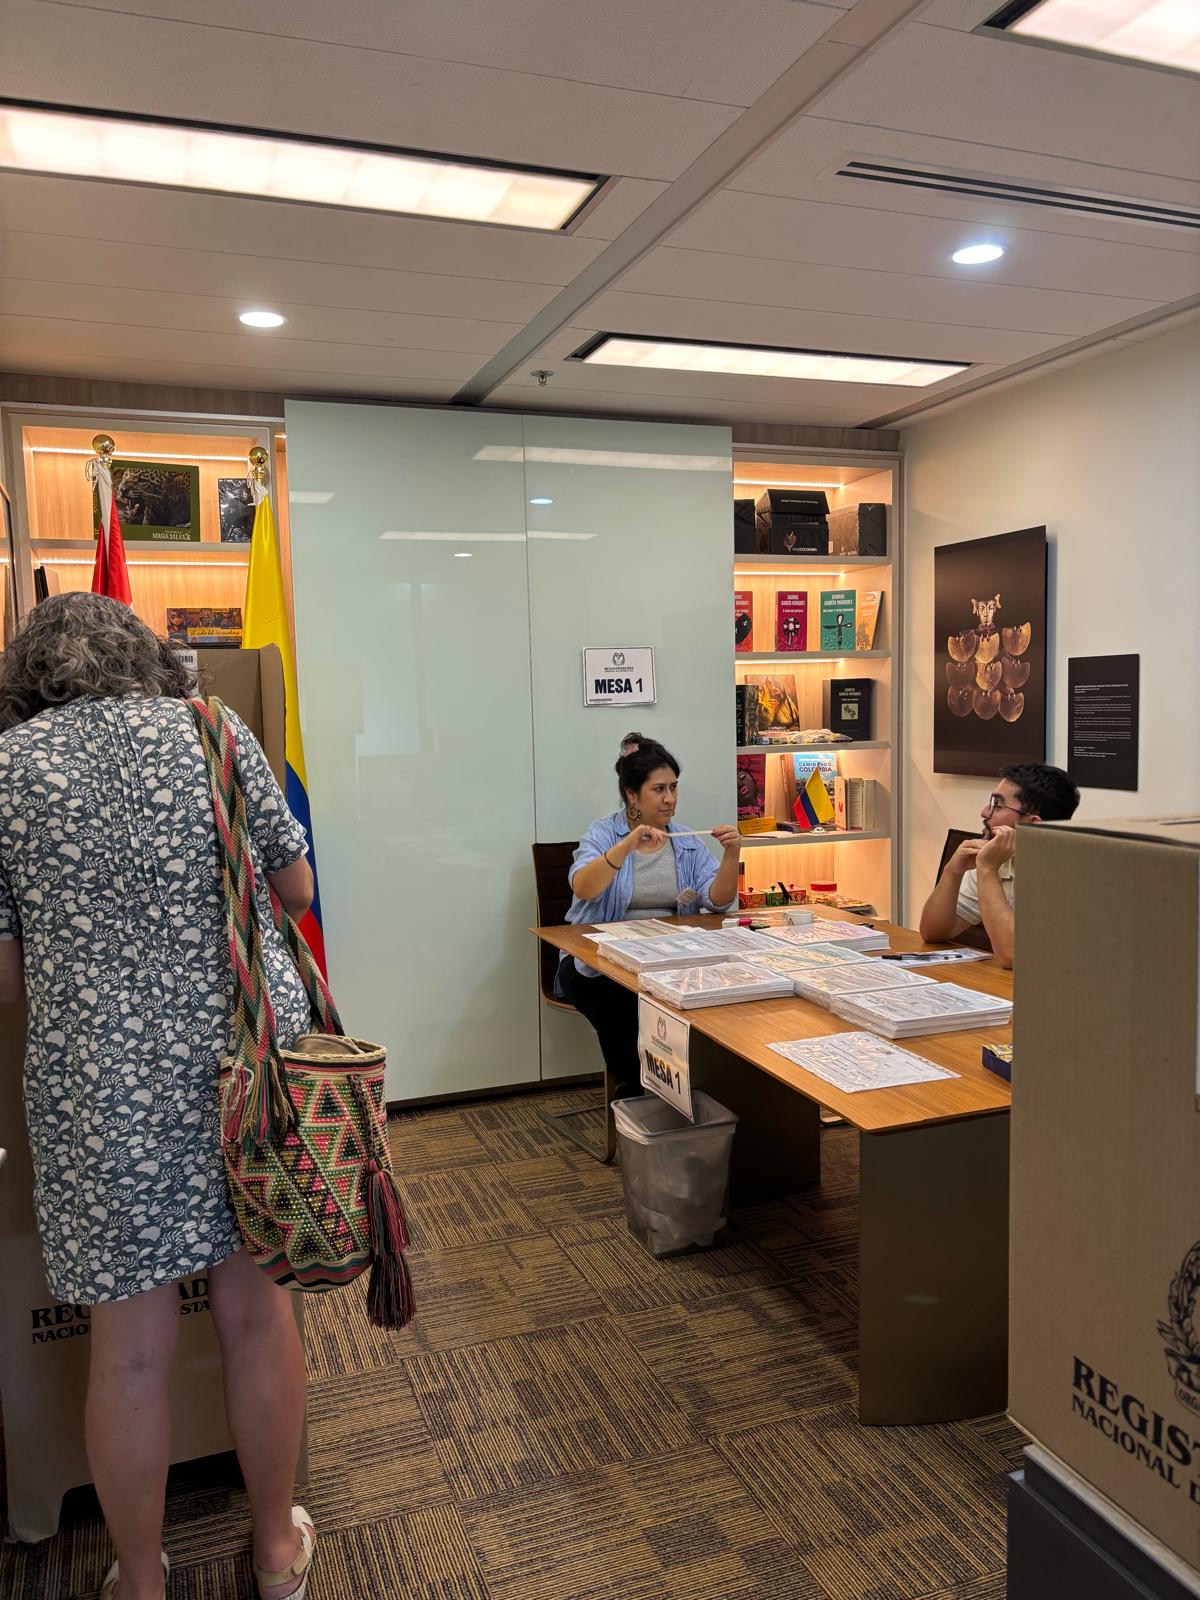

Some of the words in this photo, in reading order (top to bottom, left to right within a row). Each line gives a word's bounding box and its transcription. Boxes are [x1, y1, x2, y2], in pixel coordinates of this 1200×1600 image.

[594, 678, 633, 694] MESA
[635, 677, 643, 692] 1
[644, 1048, 674, 1090] MESA
[674, 1071, 682, 1096] 1
[31, 1322, 92, 1344] NACIO
[1072, 1355, 1200, 1468] REGIS
[1071, 1393, 1181, 1489] NACIONAL
